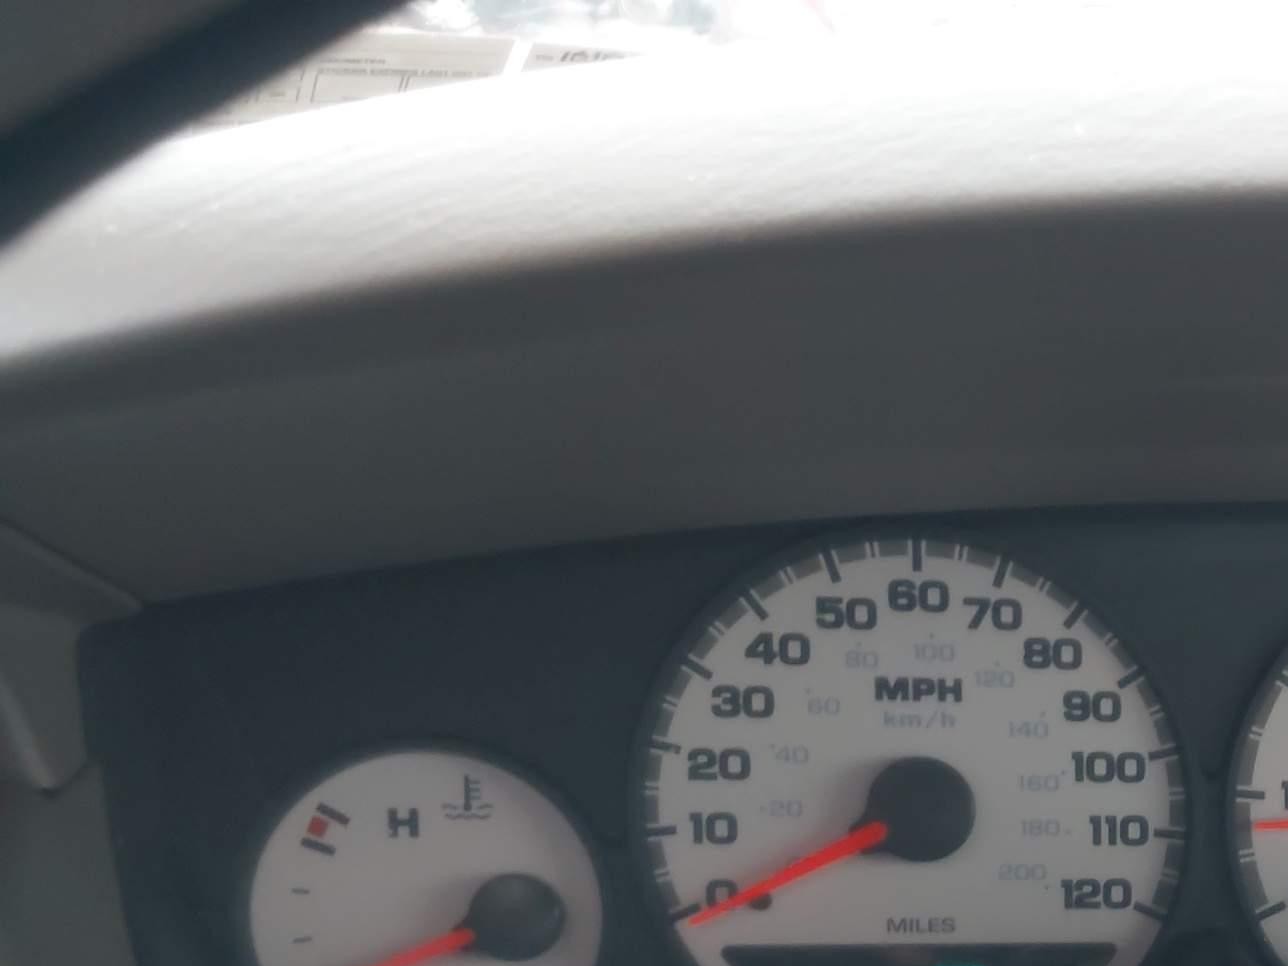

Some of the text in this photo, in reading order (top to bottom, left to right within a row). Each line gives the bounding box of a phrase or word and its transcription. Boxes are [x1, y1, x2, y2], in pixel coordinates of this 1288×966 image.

[888, 579, 950, 613] 60
[815, 596, 878, 631] 50
[962, 597, 1023, 631] 70
[744, 632, 811, 666] 40
[845, 649, 879, 670] 80
[914, 642, 955, 663] 100
[1023, 637, 1083, 671] 80
[874, 677, 963, 703] MPH
[975, 669, 1015, 688] 120
[710, 685, 775, 719] 30
[807, 697, 840, 716] 60
[1062, 690, 1122, 724] 90
[883, 710, 956, 730] km/h
[1008, 720, 1049, 739] 140
[687, 748, 751, 782] 20
[775, 745, 809, 764] 40
[1071, 752, 1146, 784] 100
[1018, 773, 1059, 792] 160
[387, 807, 420, 838] H
[769, 799, 802, 818] 20
[688, 812, 738, 845] 10
[1021, 819, 1061, 838] 180
[1089, 815, 1150, 847] 110
[998, 864, 1047, 882] 200
[1061, 878, 1133, 911] 120
[886, 917, 957, 934] MILES
